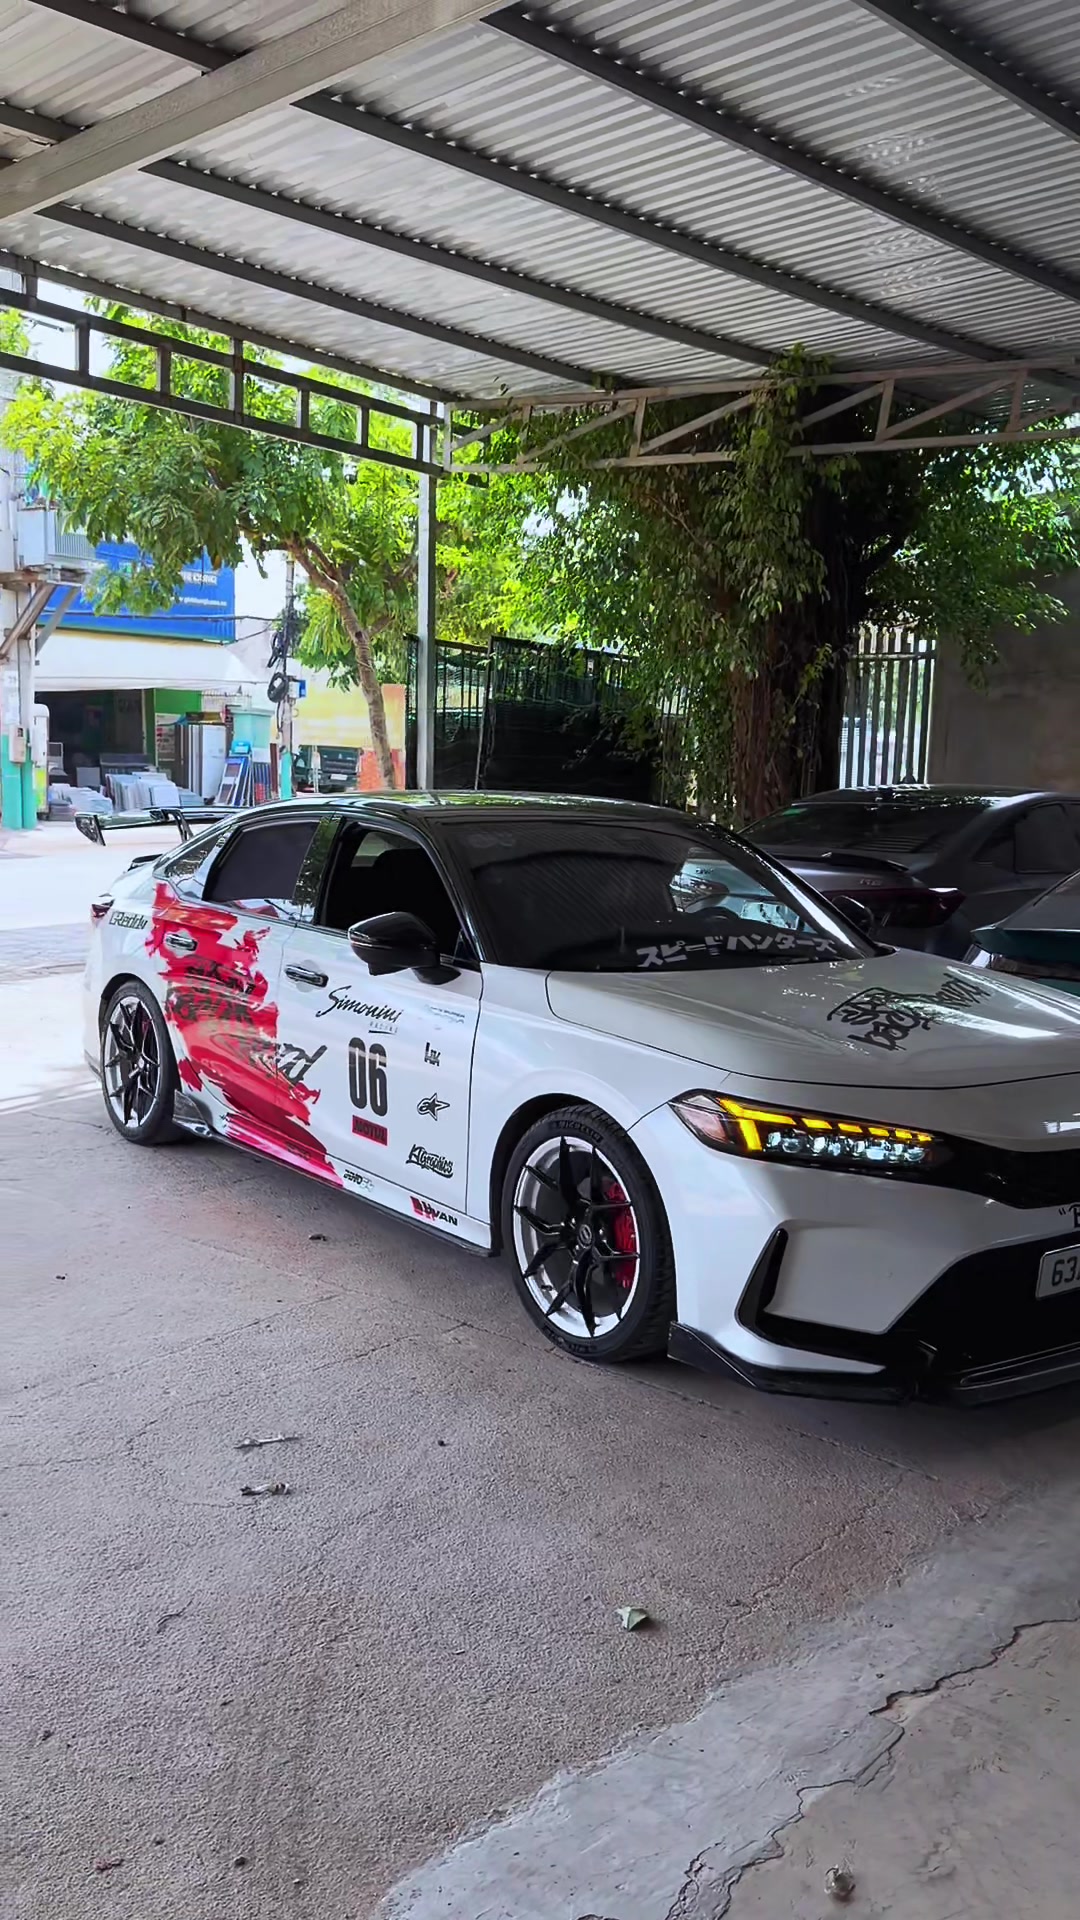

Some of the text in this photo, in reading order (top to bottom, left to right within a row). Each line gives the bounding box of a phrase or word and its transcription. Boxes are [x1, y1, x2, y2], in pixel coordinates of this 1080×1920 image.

[636, 932, 840, 968] スピードハンターズ
[315, 985, 403, 1023] Simonini
[348, 1037, 388, 1117] 06
[1051, 1256, 1080, 1287] 63
